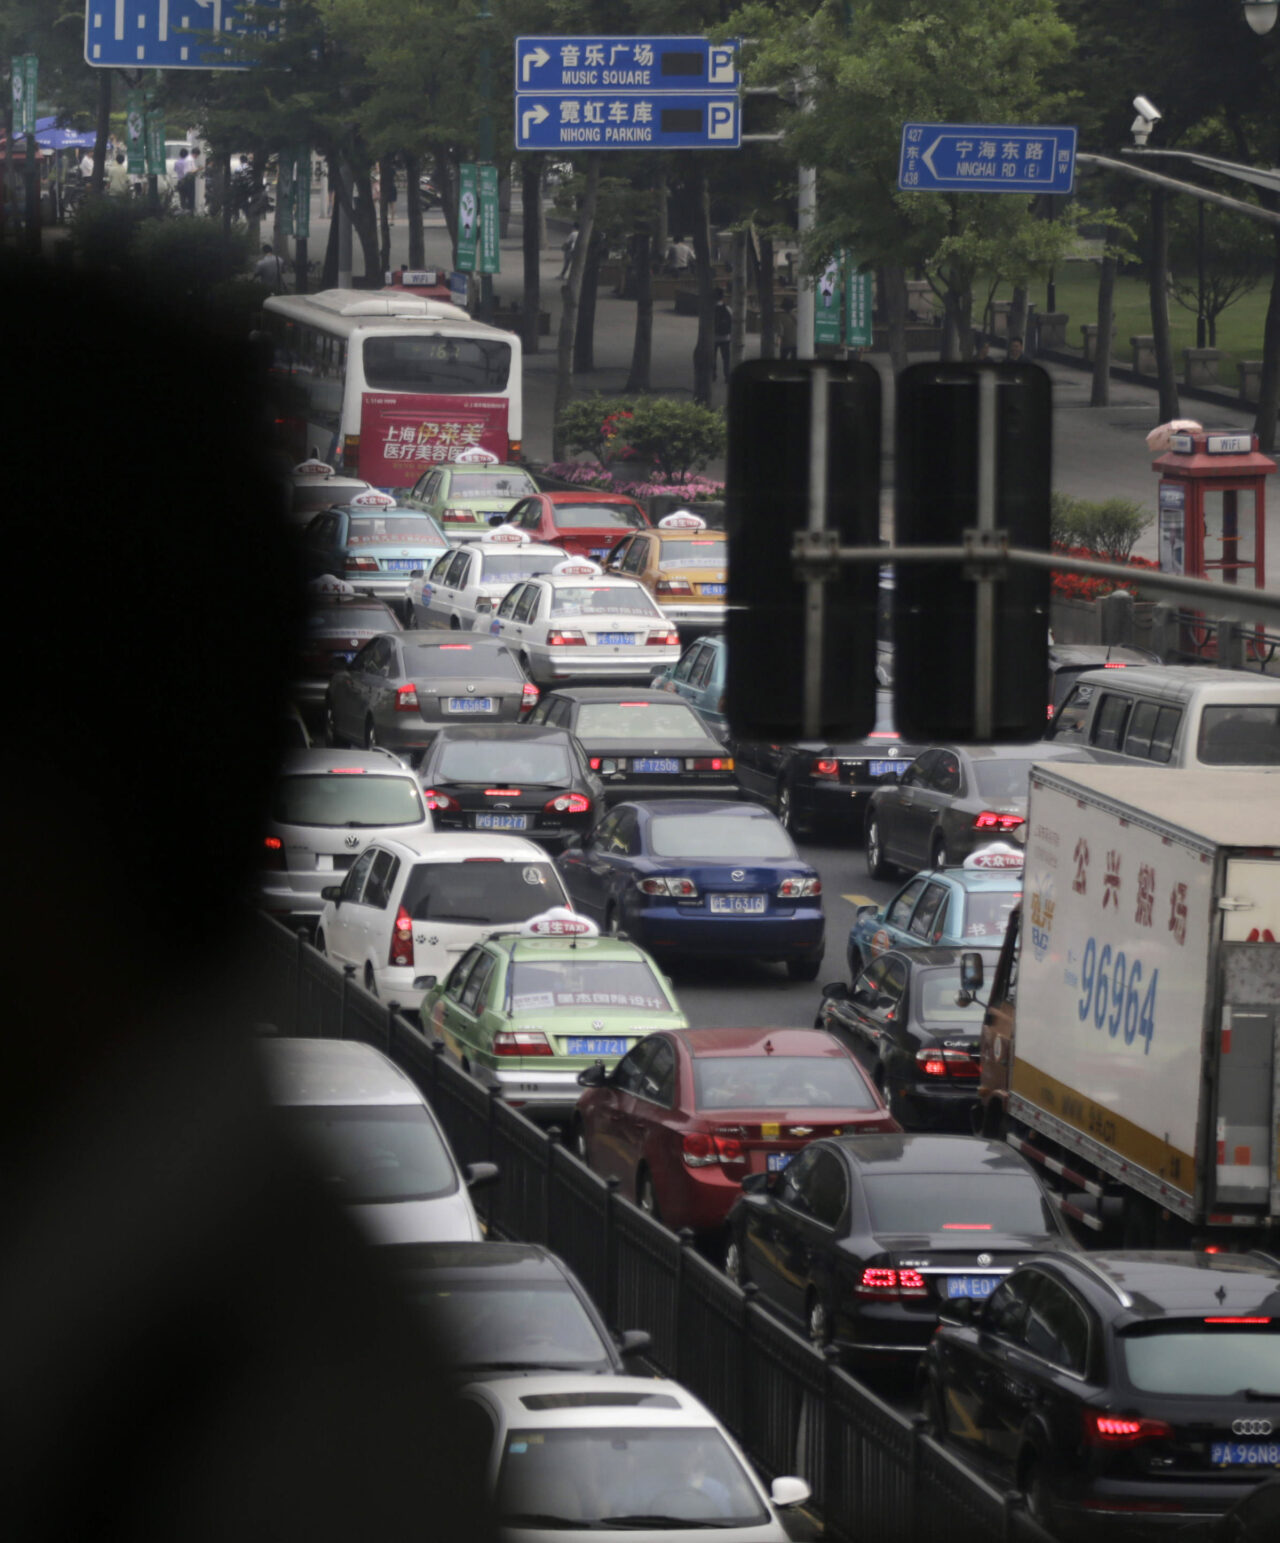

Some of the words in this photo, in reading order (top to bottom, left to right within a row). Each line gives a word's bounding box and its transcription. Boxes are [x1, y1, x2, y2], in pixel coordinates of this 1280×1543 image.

[560, 44, 654, 67] 音乐广场
[562, 71, 598, 85] MUSIC
[602, 71, 651, 85] SQUARE
[559, 101, 653, 124] 霓虹车库
[560, 128, 601, 142] NIHONG
[605, 128, 652, 142] PARKING
[907, 129, 923, 142] 427
[906, 146, 919, 159] 东
[955, 141, 1043, 160] 宁海东路
[1058, 150, 1070, 162] 西
[908, 161, 915, 171] E
[956, 162, 996, 177] NINGHAI
[1001, 163, 1016, 178] RD
[1024, 164, 1040, 178] (E)
[1058, 164, 1068, 174] W
[903, 172, 919, 186] 438
[1078, 936, 1159, 1056] 96964
